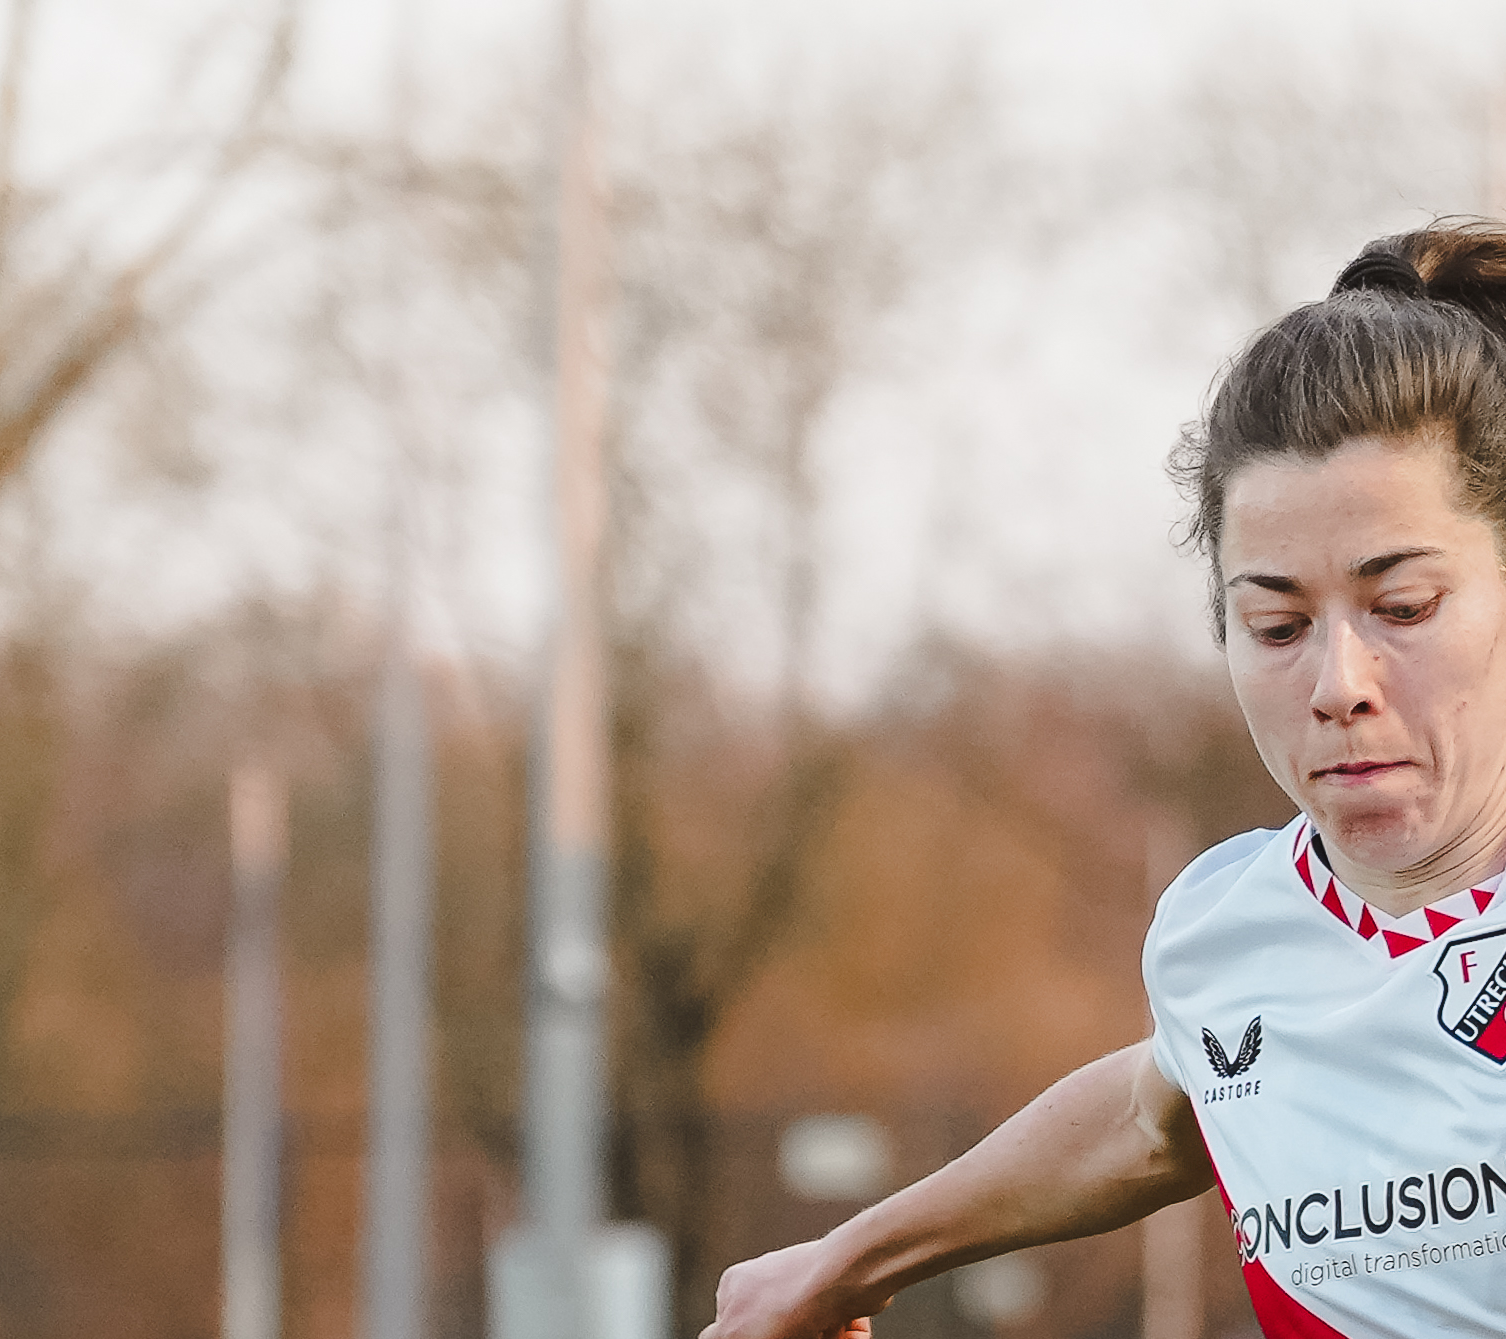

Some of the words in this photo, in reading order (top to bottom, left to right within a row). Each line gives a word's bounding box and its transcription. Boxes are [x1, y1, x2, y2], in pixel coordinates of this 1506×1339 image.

[1460, 951, 1477, 983] F
[1204, 1080, 1261, 1105] CASTORE
[1291, 1253, 1358, 1286] digital
